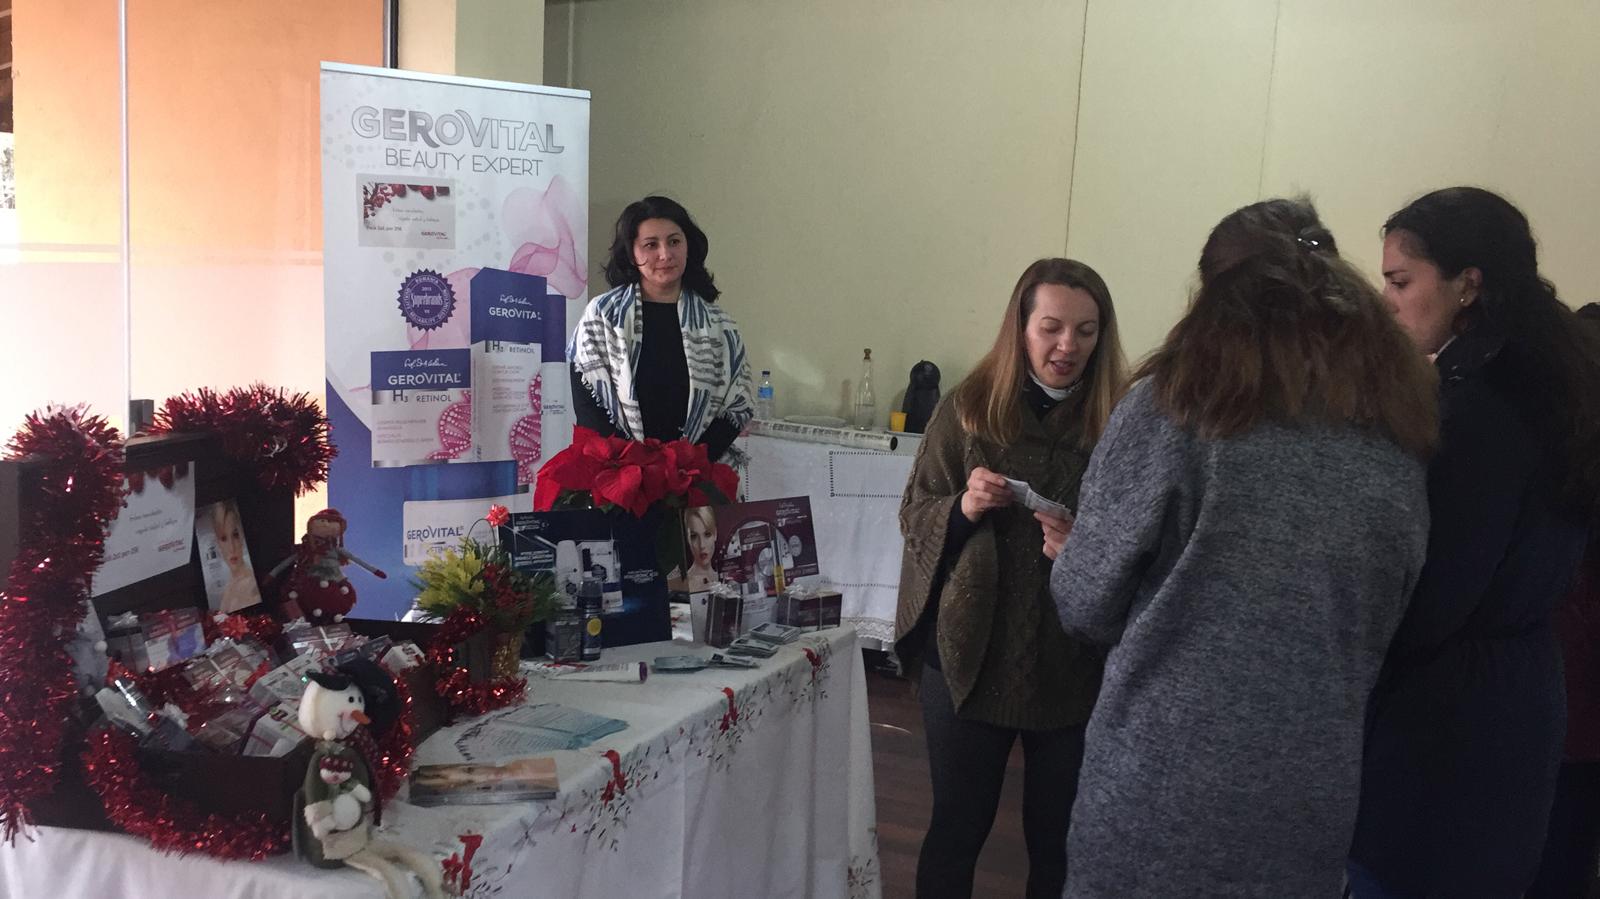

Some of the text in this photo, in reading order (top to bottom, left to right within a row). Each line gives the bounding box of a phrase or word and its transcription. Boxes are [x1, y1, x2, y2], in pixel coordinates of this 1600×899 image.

[351, 105, 565, 154] GEROVITAL
[385, 147, 543, 177] BEAUTY EXPERT
[387, 372, 462, 387] GEROVITAL
[416, 394, 452, 403] RETINOL
[407, 525, 464, 542] GEROVITAL
